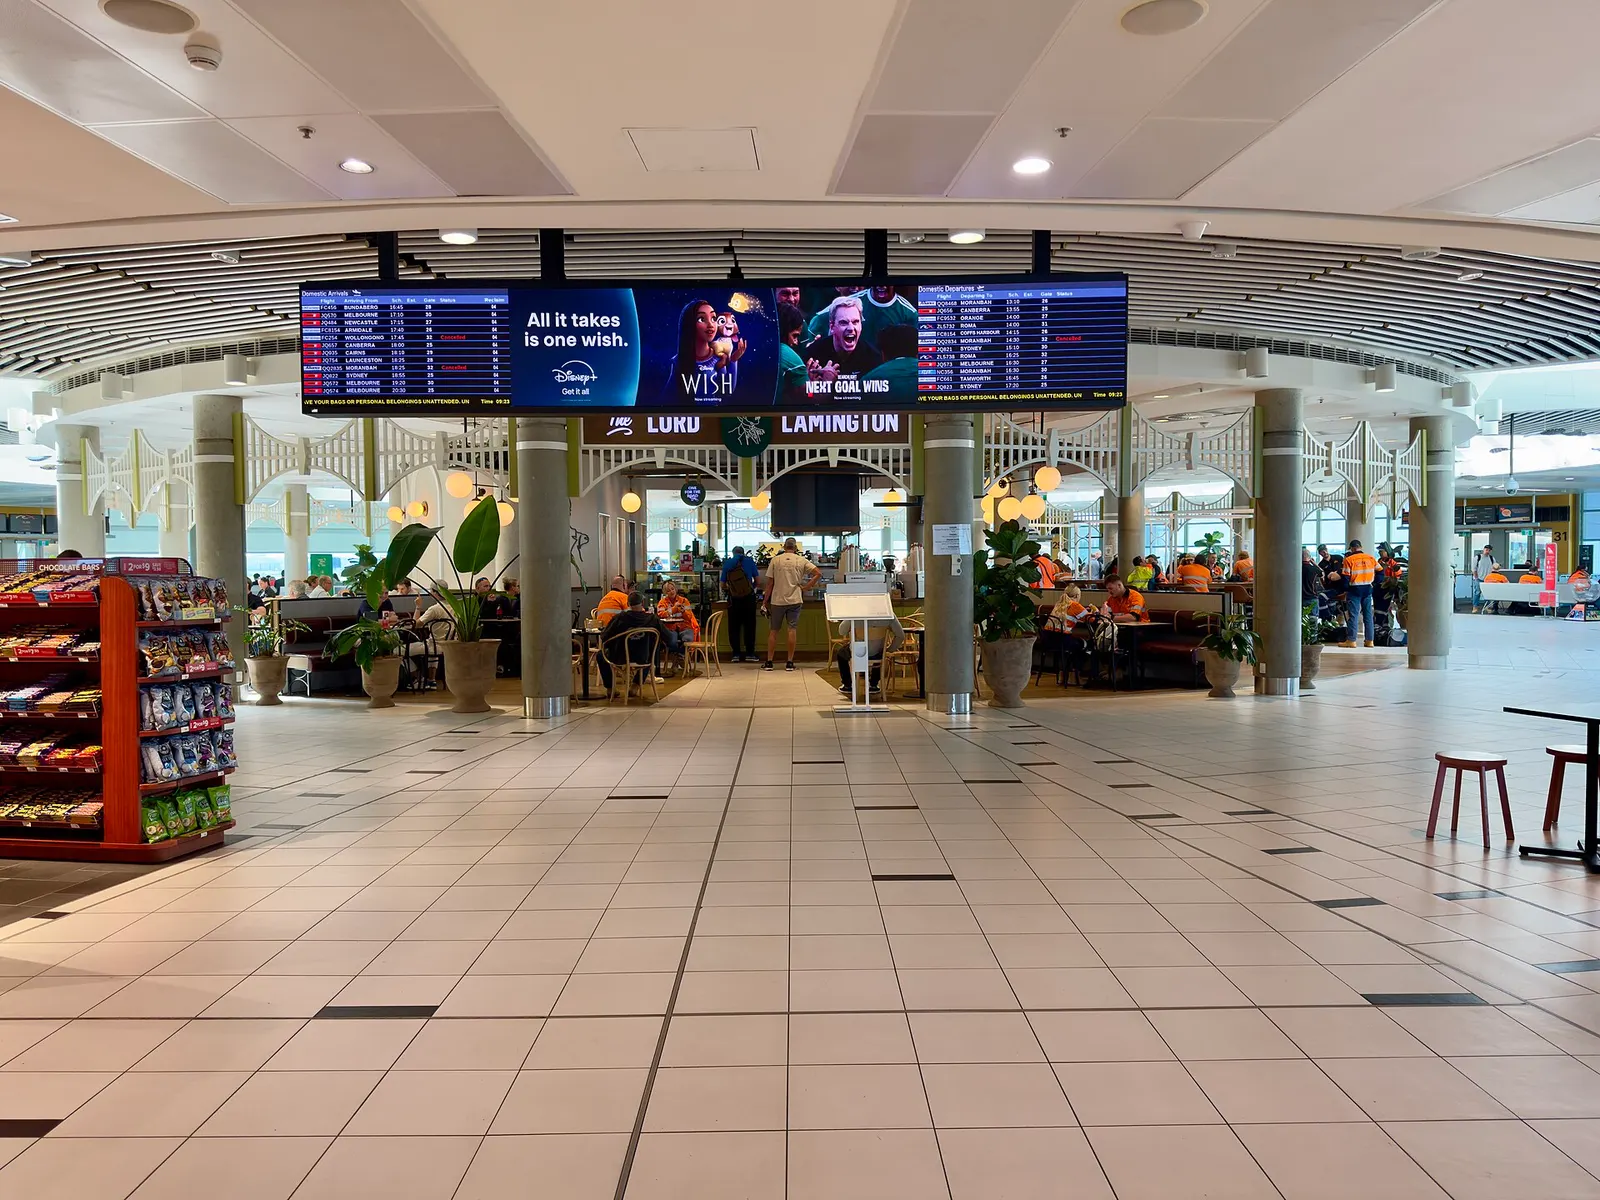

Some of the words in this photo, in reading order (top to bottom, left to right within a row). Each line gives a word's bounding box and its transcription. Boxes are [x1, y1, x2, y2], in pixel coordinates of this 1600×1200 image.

[527, 312, 550, 327] All
[555, 312, 567, 327] it
[571, 312, 620, 327] takes
[524, 332, 539, 347] is
[543, 337, 576, 347] one
[582, 332, 628, 347] wish.
[552, 369, 598, 385] Disney+
[681, 374, 732, 394] WISH
[806, 381, 832, 393] NEXT
[835, 381, 861, 393] GOAL
[863, 380, 889, 392] WINS
[647, 416, 699, 433] LORD
[782, 414, 898, 433] LAMINGTON
[1554, 532, 1567, 541] 31
